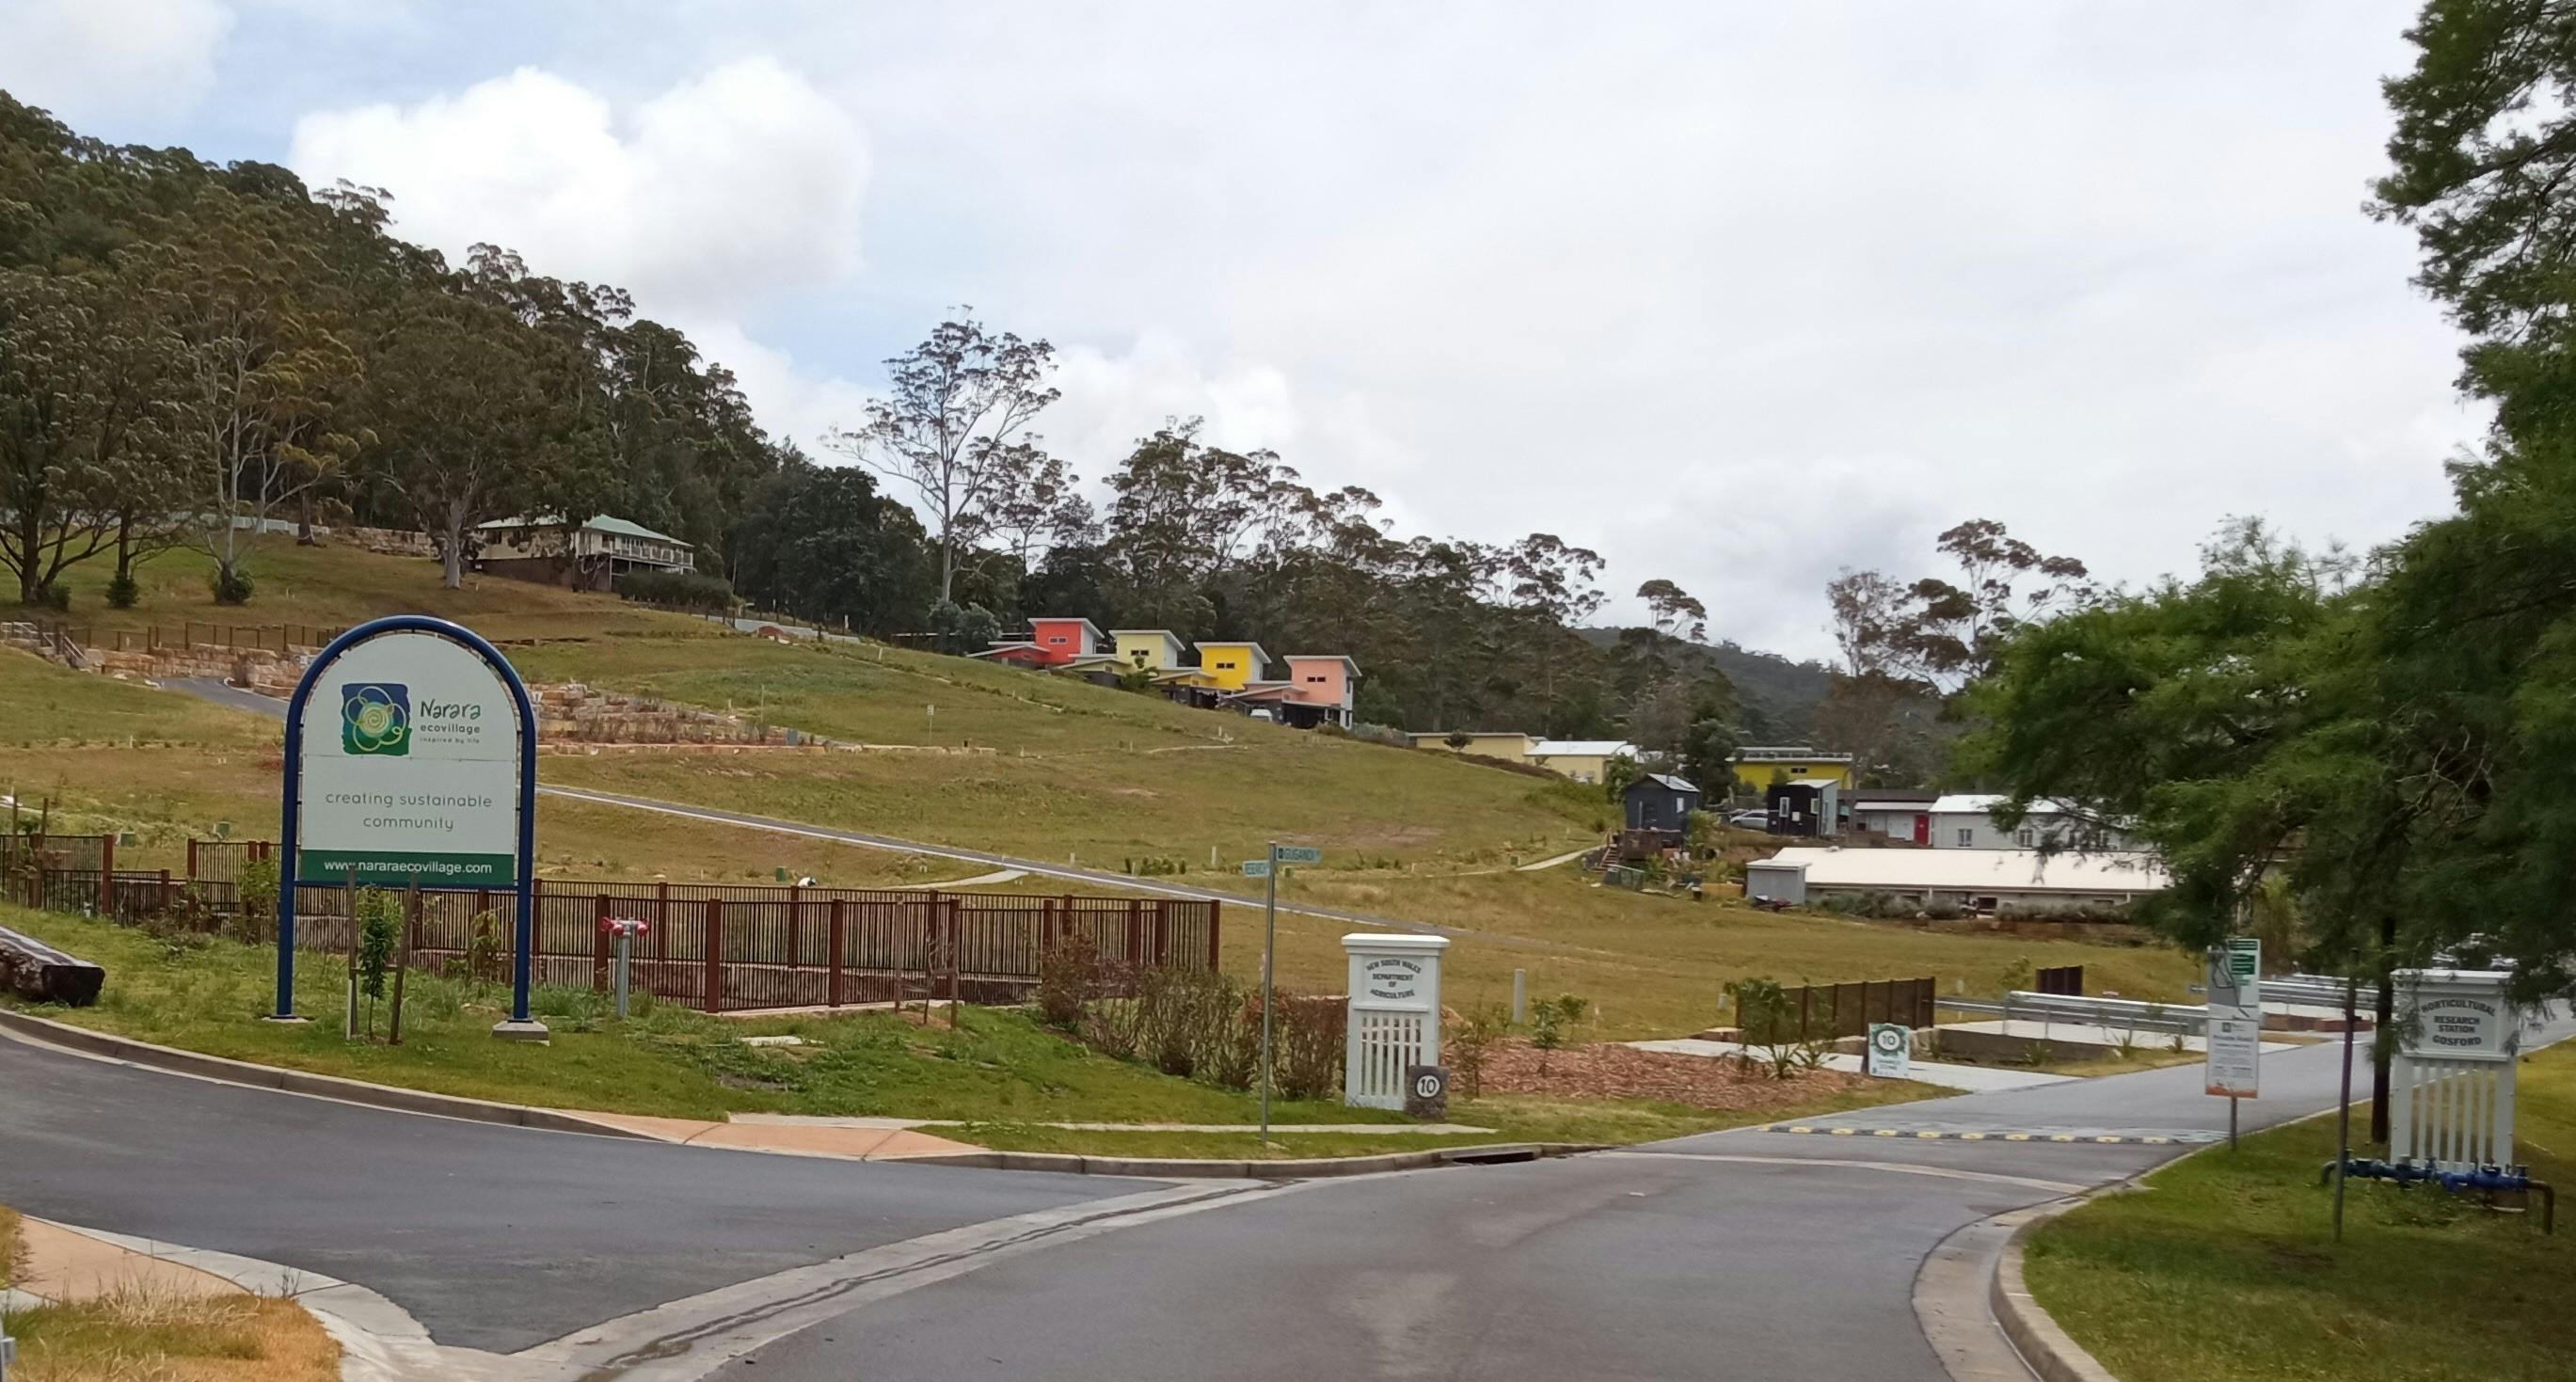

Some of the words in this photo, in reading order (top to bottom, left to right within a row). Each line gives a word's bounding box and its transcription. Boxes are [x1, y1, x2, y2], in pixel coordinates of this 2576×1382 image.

[421, 698, 481, 720] Narara
[420, 723, 481, 735] ecovillage
[326, 793, 393, 808] creating
[399, 795, 492, 808] sustainable
[363, 817, 453, 833] community
[1366, 961, 1379, 971] NEW
[1402, 961, 1422, 974] WALES
[1373, 973, 1414, 981] DEPARTMENT
[1370, 989, 1415, 999] AGRICULTURE
[2421, 999, 2496, 1017] HORTICULTURAL
[2434, 1016, 2480, 1025] RESEARCH
[2438, 1025, 2475, 1033] STATION
[1882, 1035, 1896, 1045] 10
[2432, 1035, 2481, 1046] GOSFORD
[1420, 1077, 1437, 1094] 10
